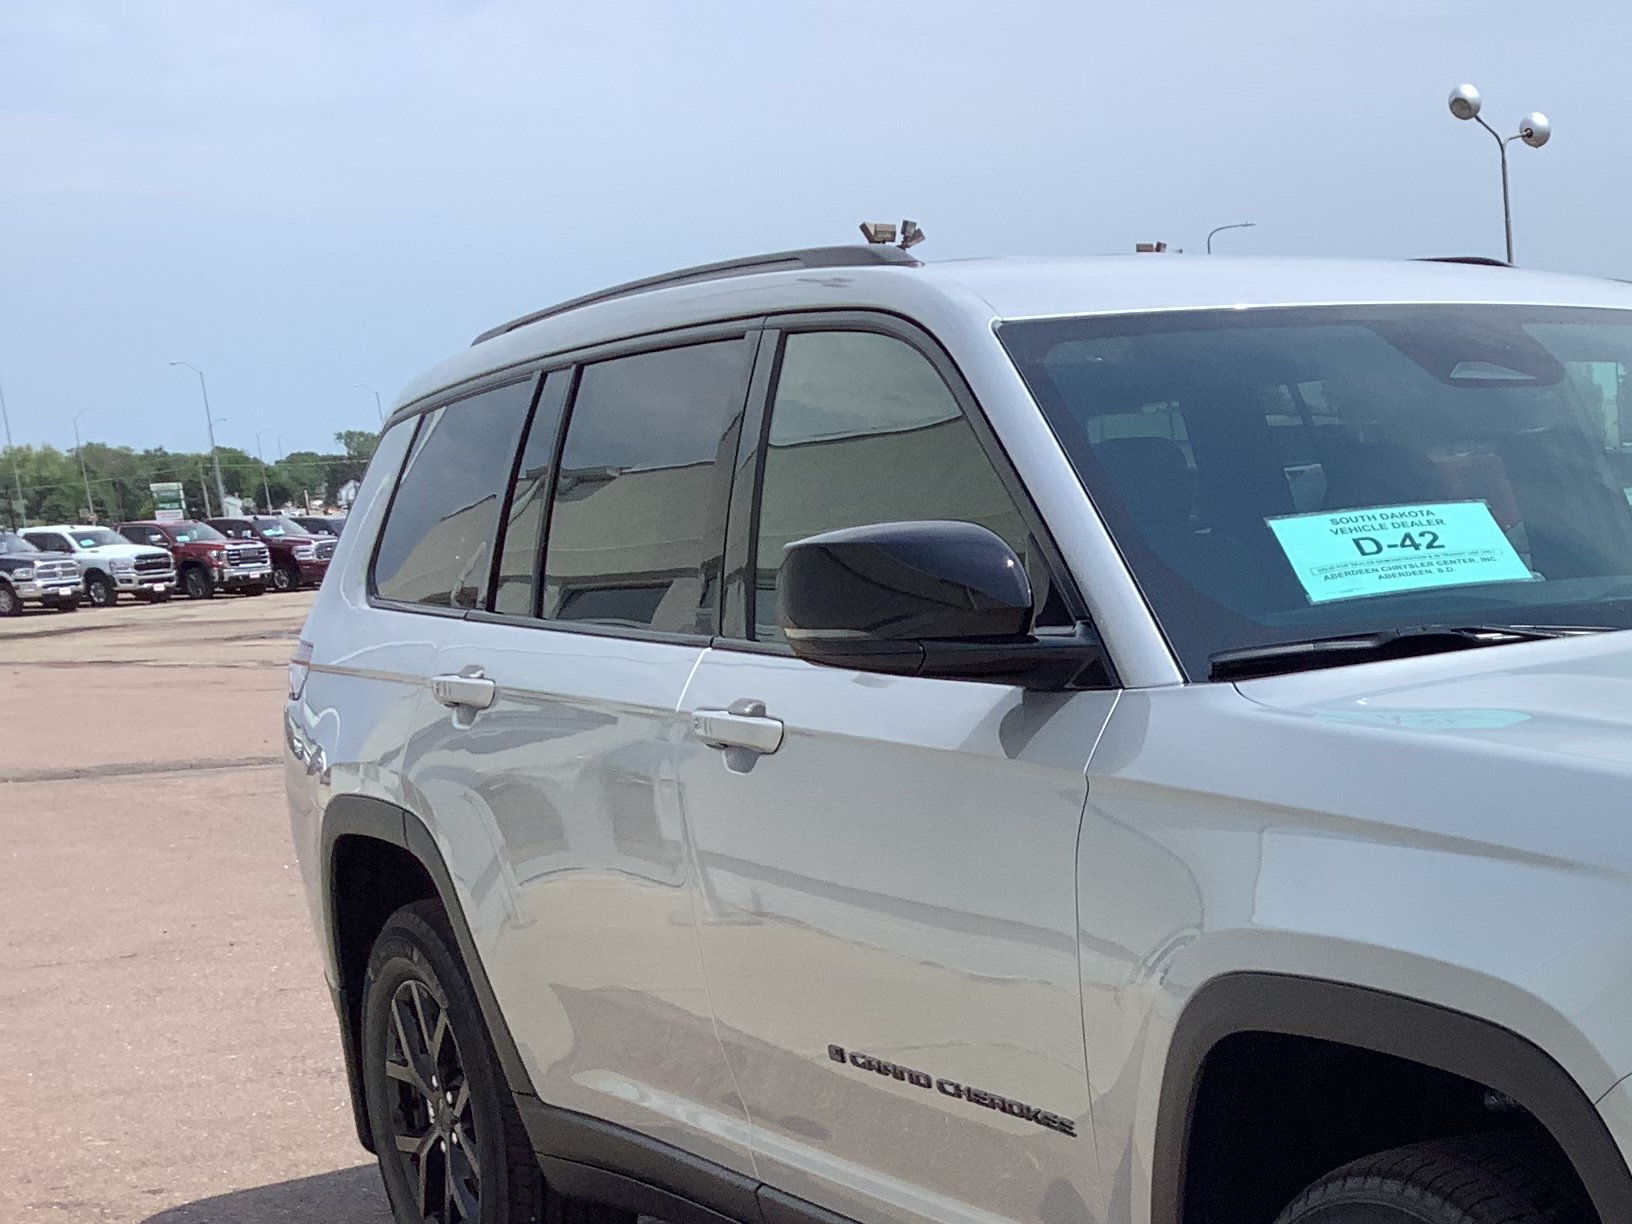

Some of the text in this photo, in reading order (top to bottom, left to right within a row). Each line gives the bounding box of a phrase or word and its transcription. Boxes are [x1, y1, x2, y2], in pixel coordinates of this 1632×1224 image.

[1329, 509, 1436, 526] SOUTH DAKOTA
[1329, 518, 1446, 536] VEHICLE DEALER
[1351, 530, 1446, 557] D-42
[1323, 567, 1380, 581] ABERDEEN
[1380, 560, 1435, 572] CHRYSLER
[848, 1051, 1078, 1138] GRAND CHEROKEE
